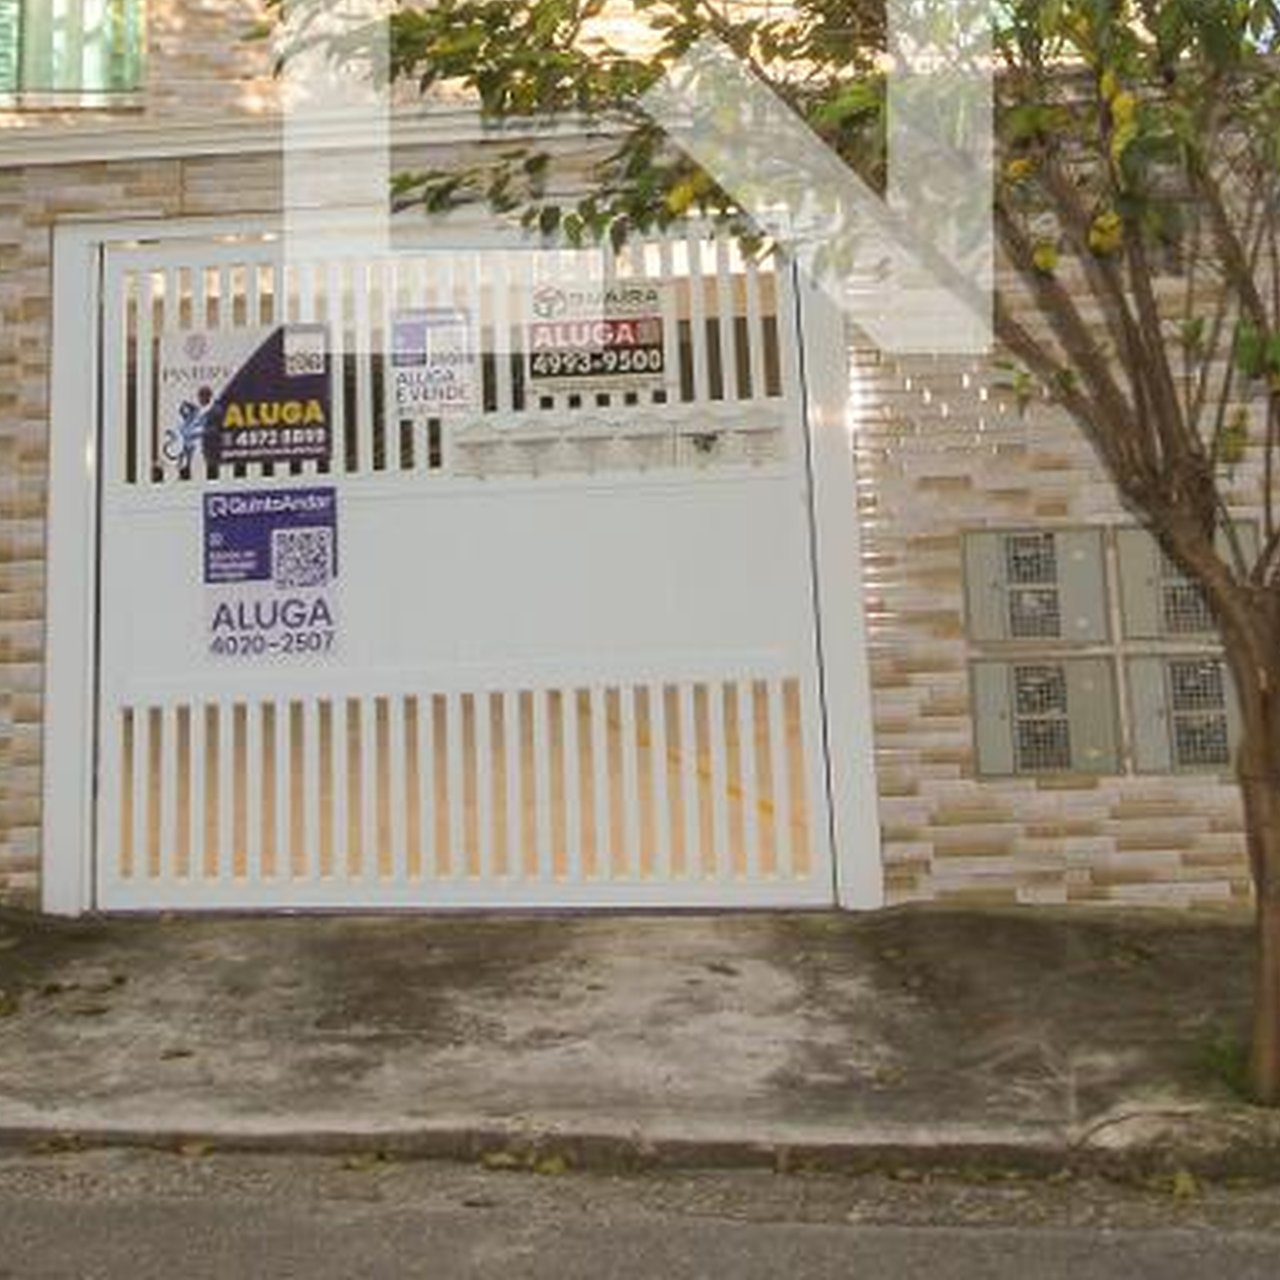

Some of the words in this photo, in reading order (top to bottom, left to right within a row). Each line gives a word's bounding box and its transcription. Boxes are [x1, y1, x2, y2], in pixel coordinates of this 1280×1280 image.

[534, 322, 636, 348] ALUGA
[532, 349, 662, 374] 4993-9500
[223, 399, 326, 428] ALUGA
[230, 494, 332, 516] QuintoAndar
[211, 597, 334, 632] ALUGA
[210, 631, 335, 656] 4020-2507
